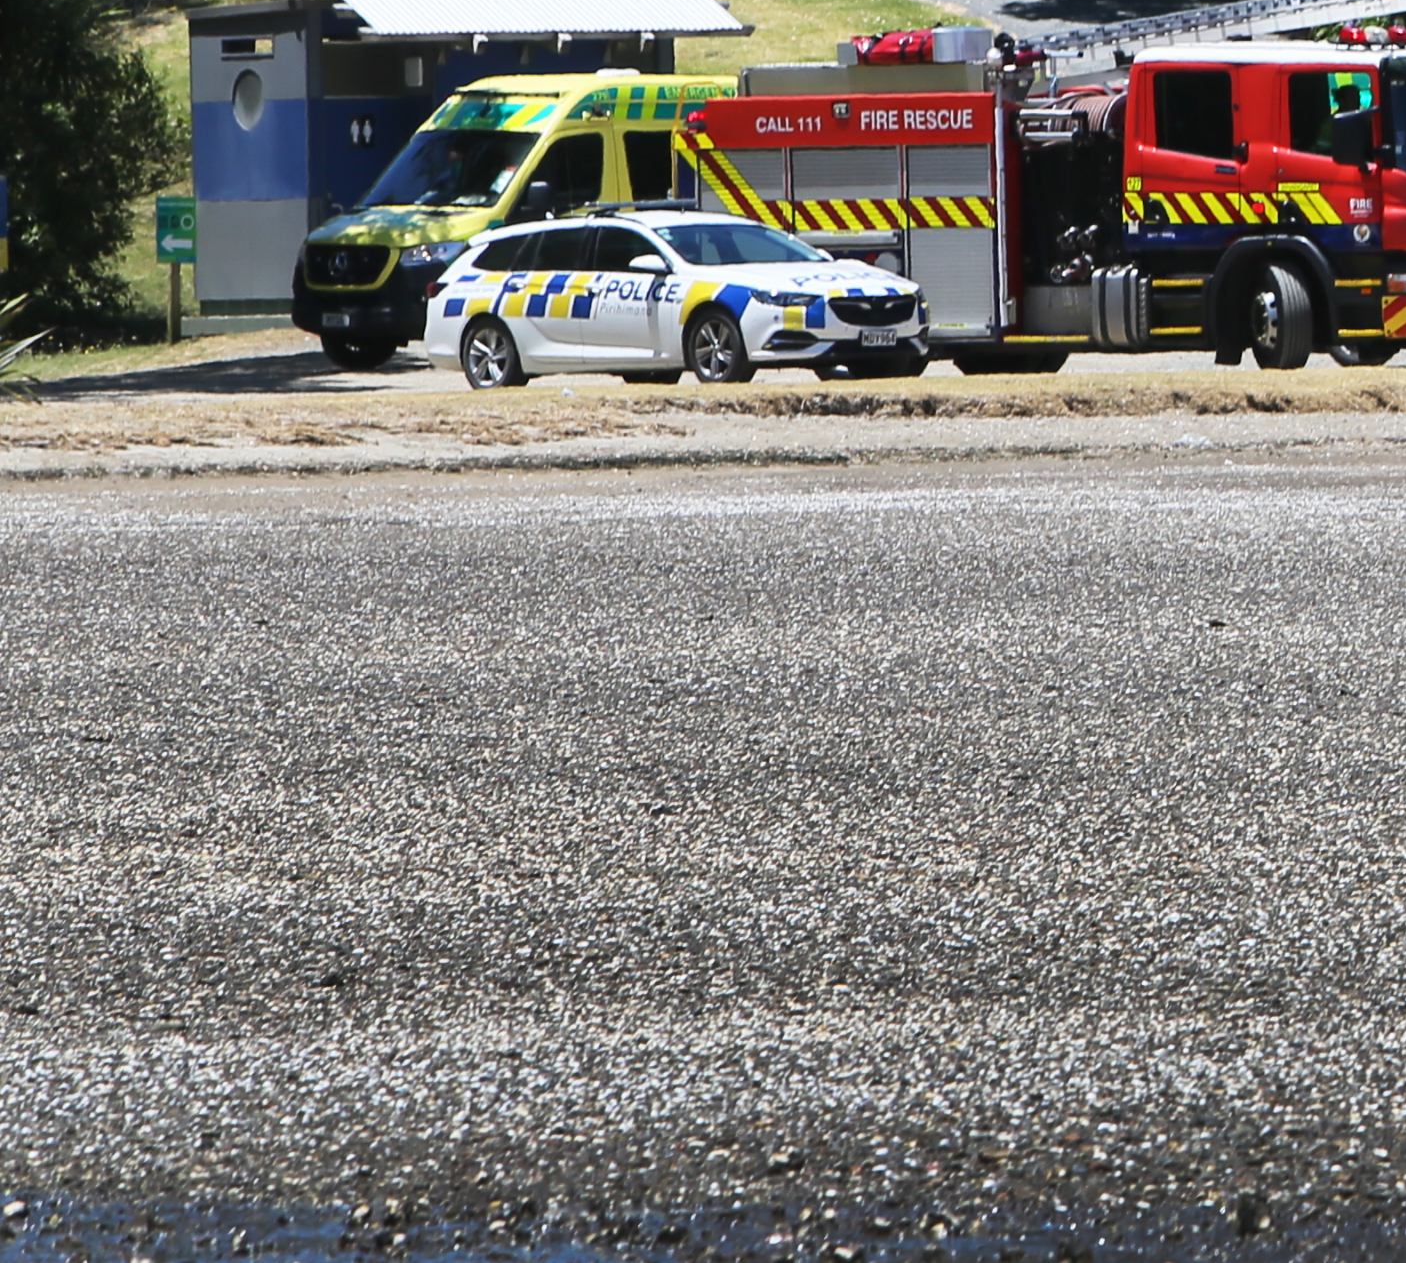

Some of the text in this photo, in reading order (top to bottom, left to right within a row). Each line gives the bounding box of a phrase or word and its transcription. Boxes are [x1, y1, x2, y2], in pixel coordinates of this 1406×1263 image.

[756, 116, 822, 133] CALL 111
[860, 109, 973, 131] FIRE RESCUE
[1349, 198, 1373, 209] FIRE
[604, 279, 681, 303] POLICE
[600, 303, 653, 317] Pirihimana
